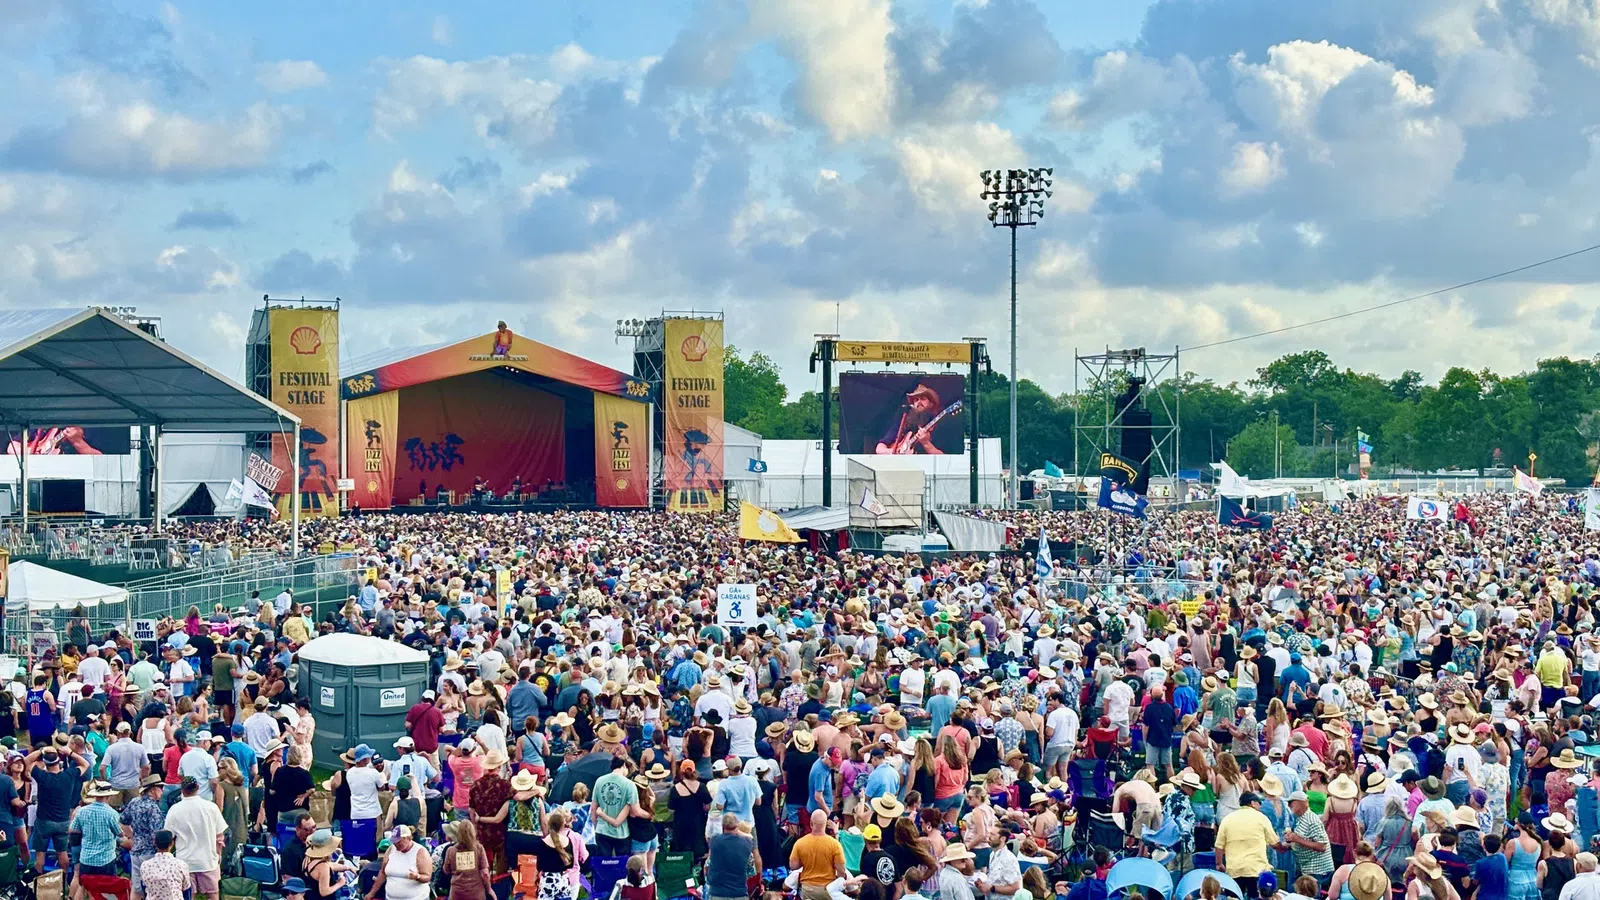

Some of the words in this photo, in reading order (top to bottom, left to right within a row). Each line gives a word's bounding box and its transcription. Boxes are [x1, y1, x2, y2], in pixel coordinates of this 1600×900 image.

[279, 371, 332, 387] FESTIVAL
[672, 377, 717, 391] FESTIVAL
[287, 390, 326, 405] STAGE
[678, 394, 711, 408] STAGE
[365, 450, 381, 459] JAZZ
[613, 450, 629, 459] JAZZ
[365, 461, 381, 470] FEST
[613, 460, 629, 469] FEST
[136, 622, 151, 631] BIG
[134, 631, 154, 639] CHIEF
[31, 702, 41, 716] 11
